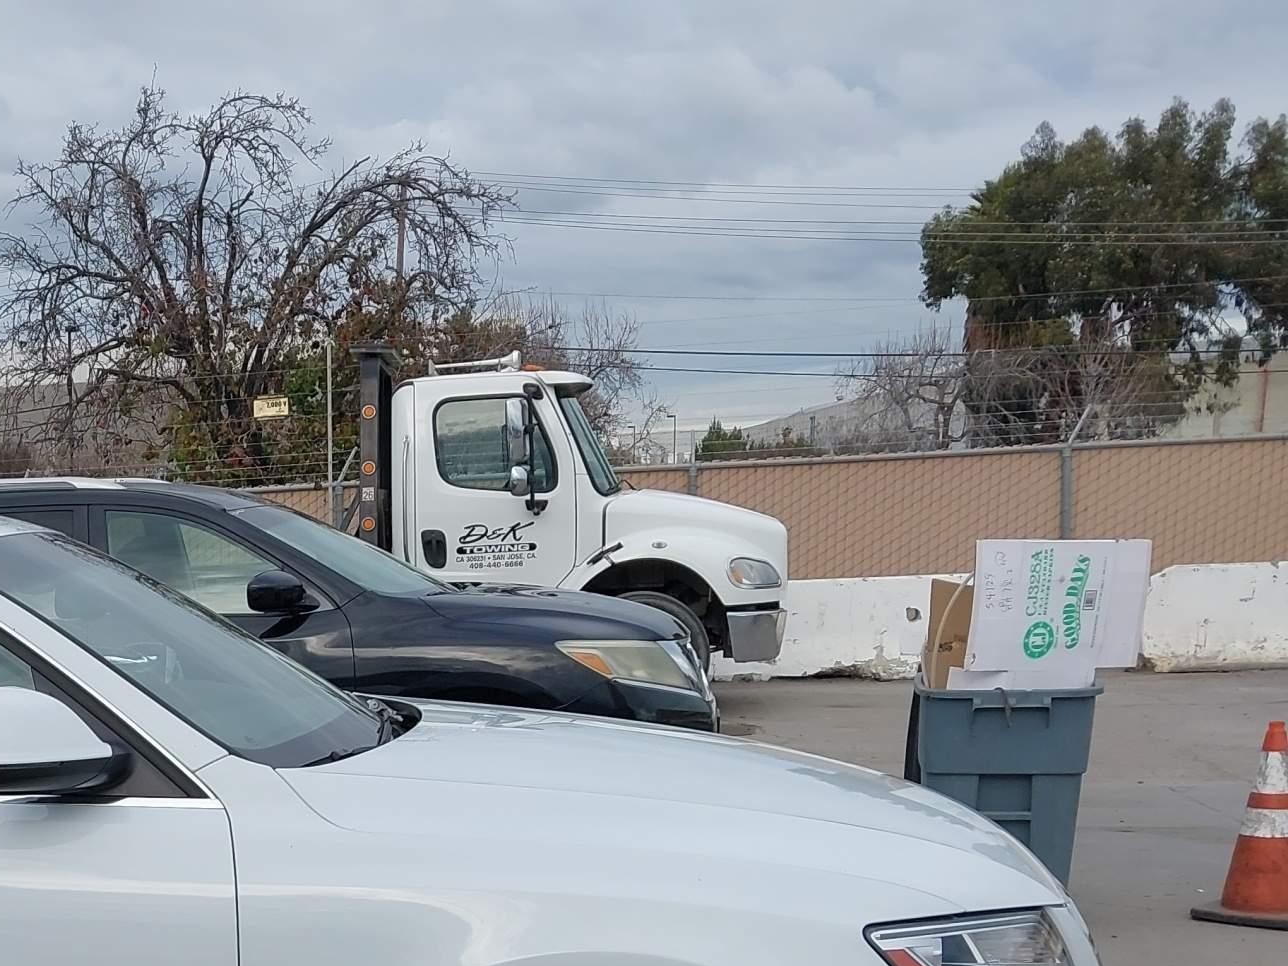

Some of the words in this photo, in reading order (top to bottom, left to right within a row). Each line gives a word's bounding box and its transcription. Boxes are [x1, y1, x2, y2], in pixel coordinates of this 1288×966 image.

[458, 521, 535, 544] D&K
[462, 544, 530, 554] TOWING
[1025, 550, 1043, 616] CJ328A
[1065, 554, 1091, 597] DAYS
[1031, 632, 1047, 650] CJ
[1062, 603, 1079, 650] GOOD
